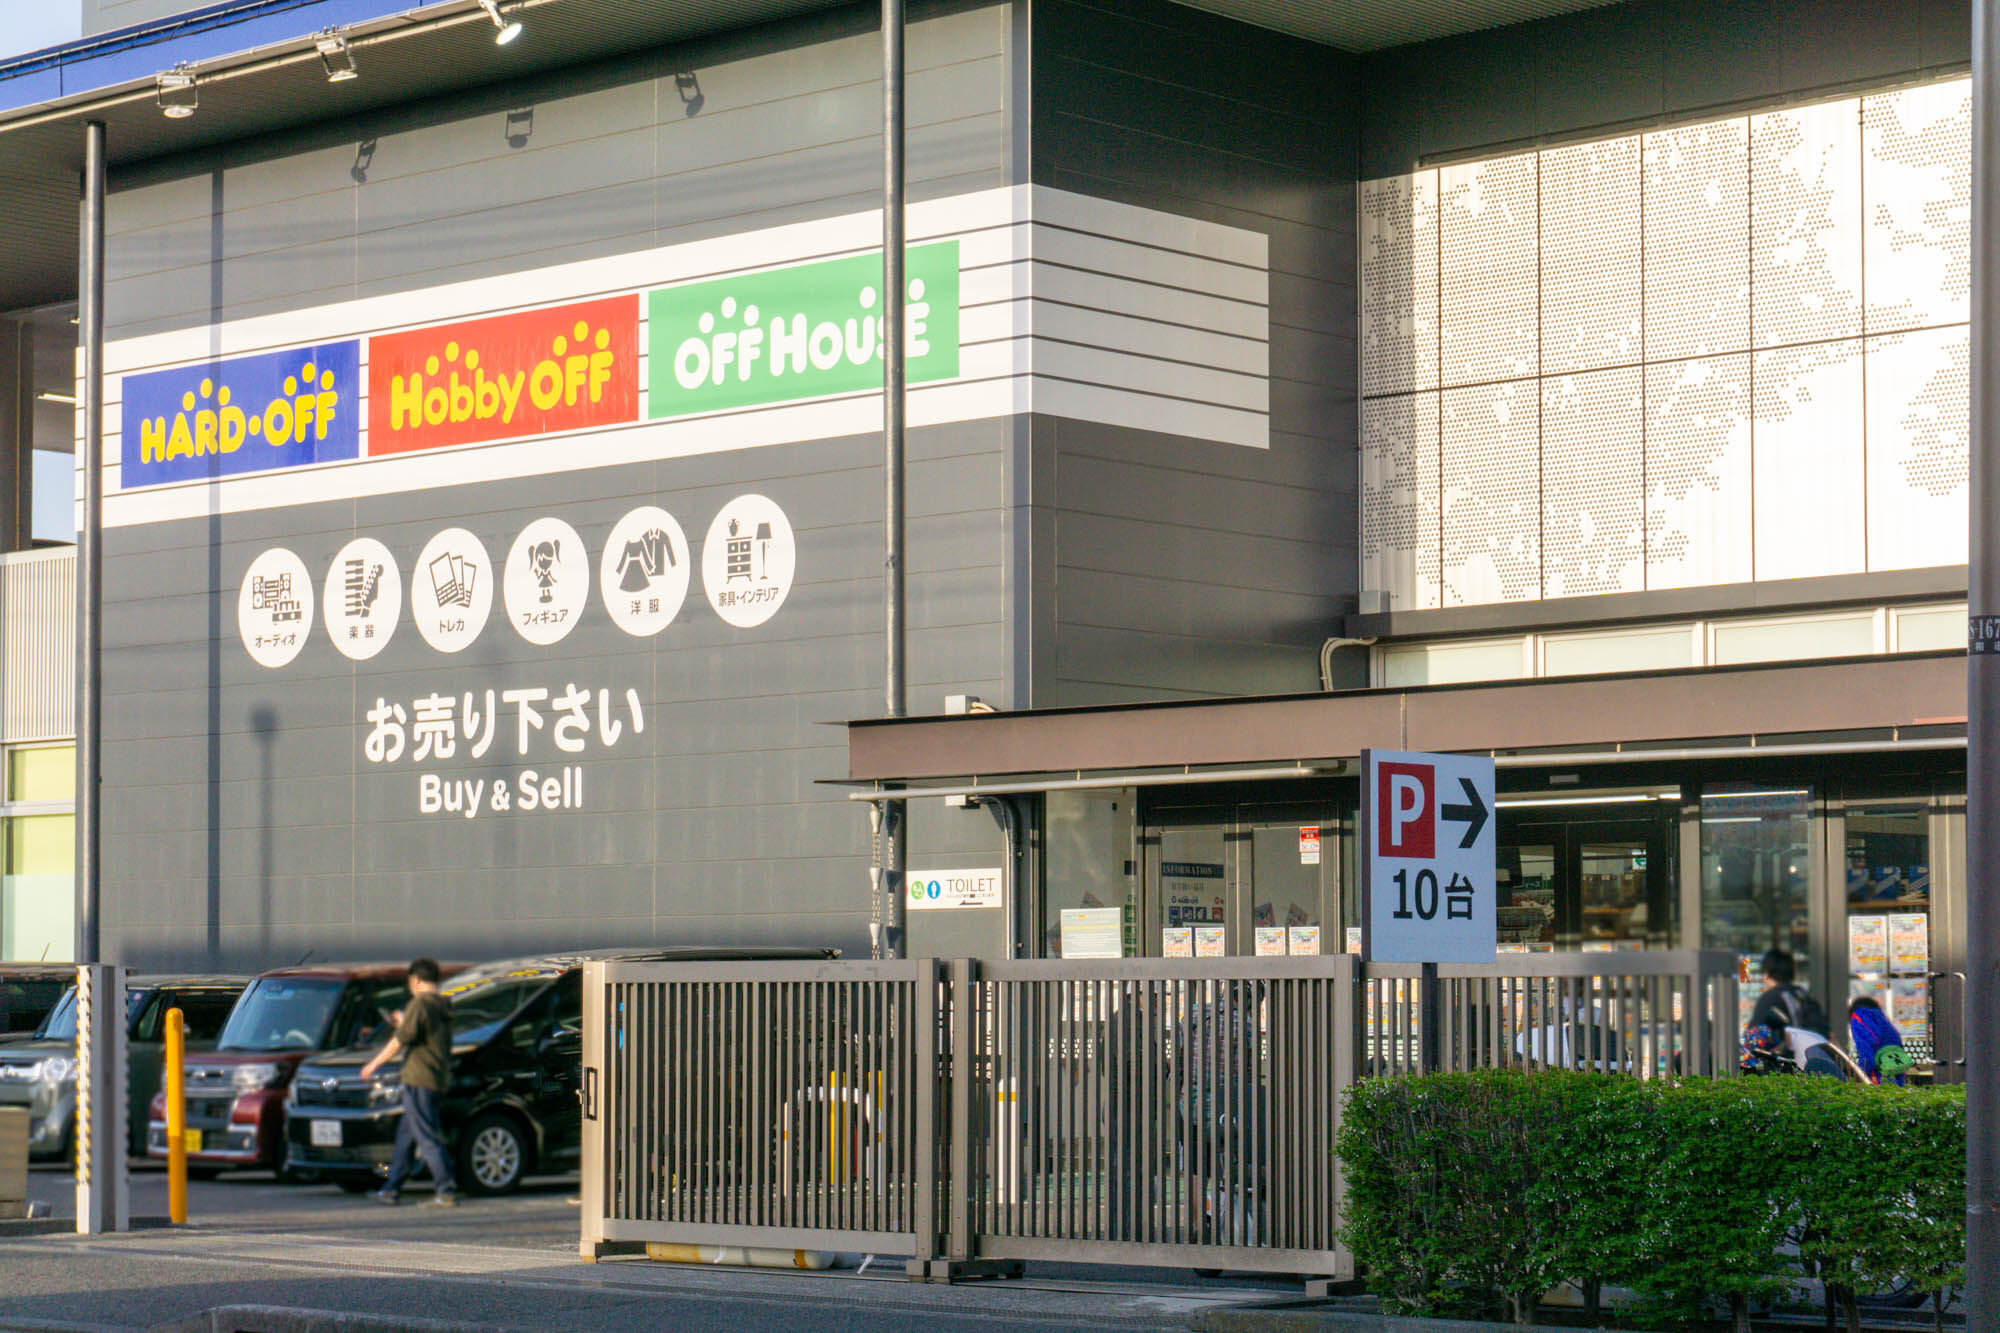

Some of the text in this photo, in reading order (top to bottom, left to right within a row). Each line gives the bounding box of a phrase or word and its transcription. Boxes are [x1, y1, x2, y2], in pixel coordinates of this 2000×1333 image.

[674, 327, 764, 390] OFF
[390, 351, 614, 430] Hobby OFF
[255, 632, 297, 649] オーディオ
[440, 618, 465, 633] トレカ
[522, 608, 569, 626] フィギュア
[364, 683, 644, 763] お売り下さい
[420, 766, 583, 819] Buy & Sell
[1391, 773, 1425, 847] P
[946, 877, 996, 892] TOILET
[1162, 863, 1212, 875] INFORMATION
[1392, 868, 1475, 921] 10台
